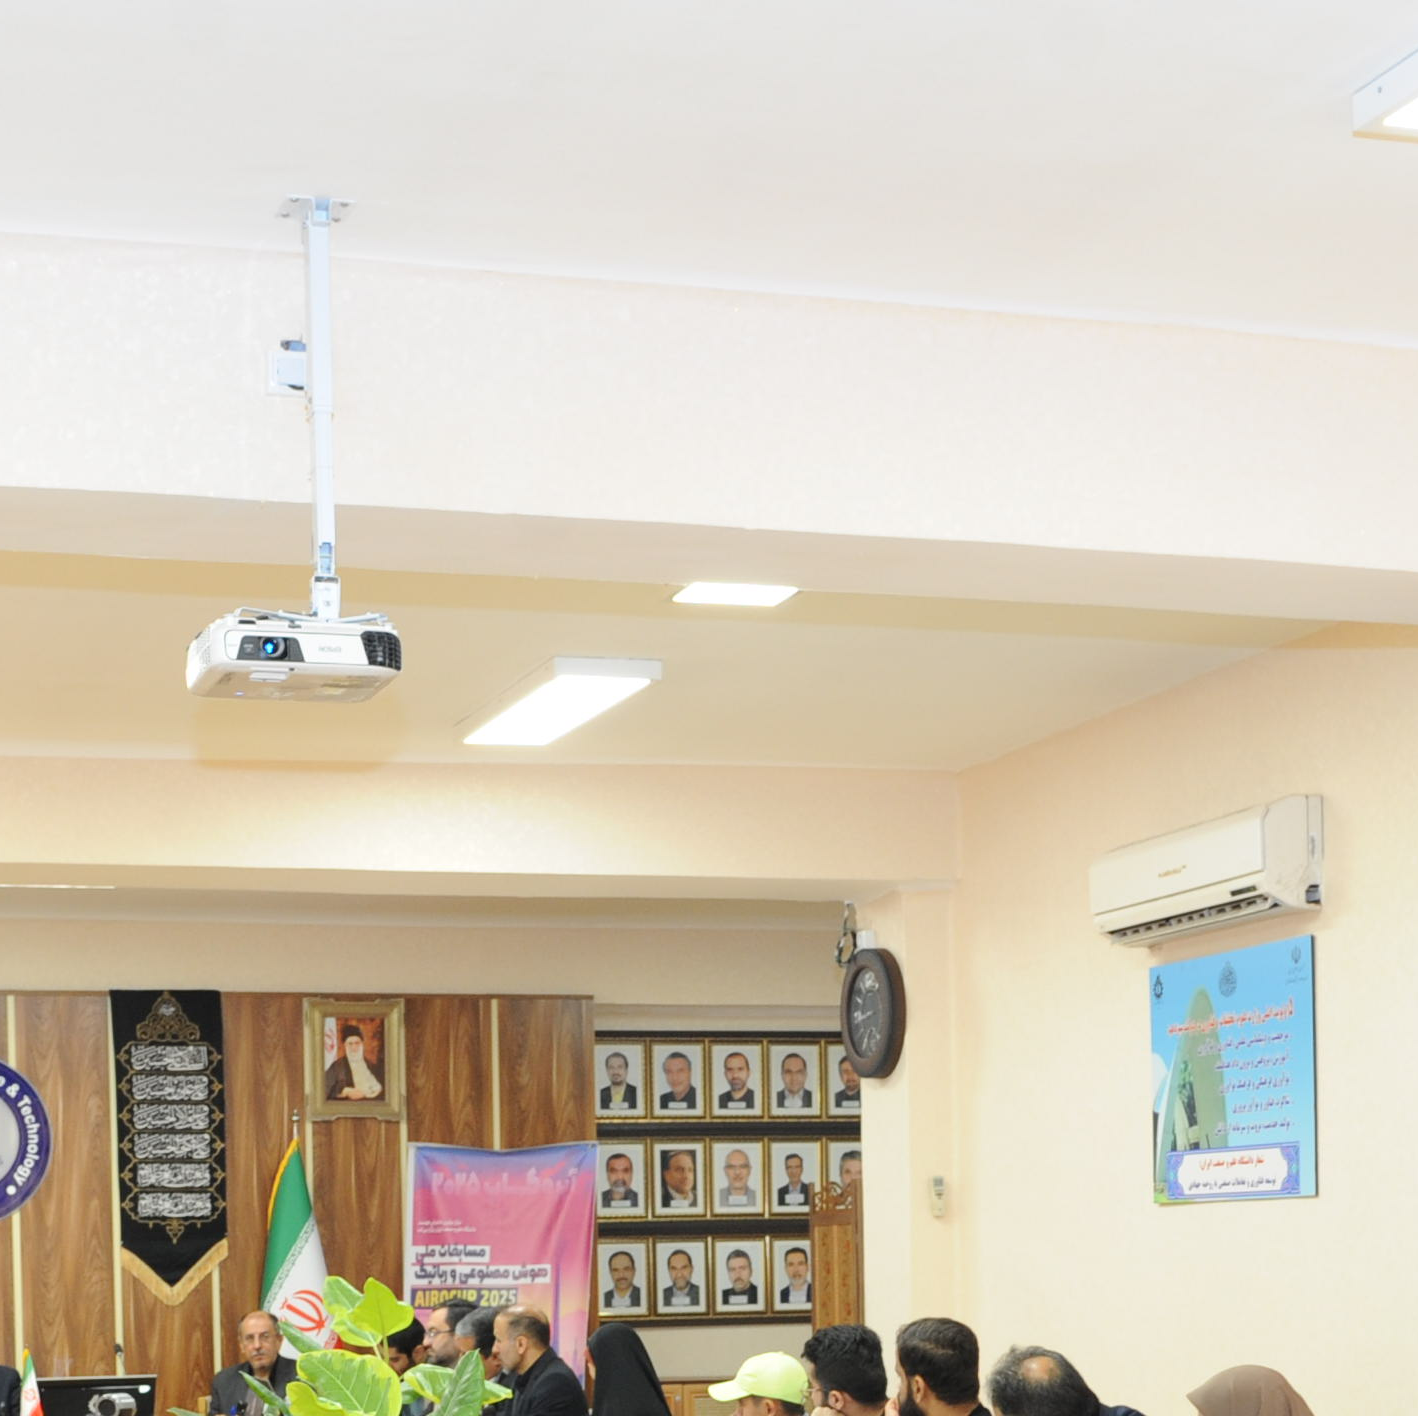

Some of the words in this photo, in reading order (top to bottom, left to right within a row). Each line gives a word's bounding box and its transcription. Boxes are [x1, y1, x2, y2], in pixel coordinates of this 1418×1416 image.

[6, 1083, 20, 1098] &
[13, 1095, 40, 1187] Technology
[415, 1245, 437, 1263] ملی
[438, 1244, 486, 1263] مسابقات
[414, 1265, 450, 1286] رباتیک
[450, 1268, 457, 1281] و
[459, 1265, 511, 1285] مصنوعی
[513, 1262, 548, 1281] هوش
